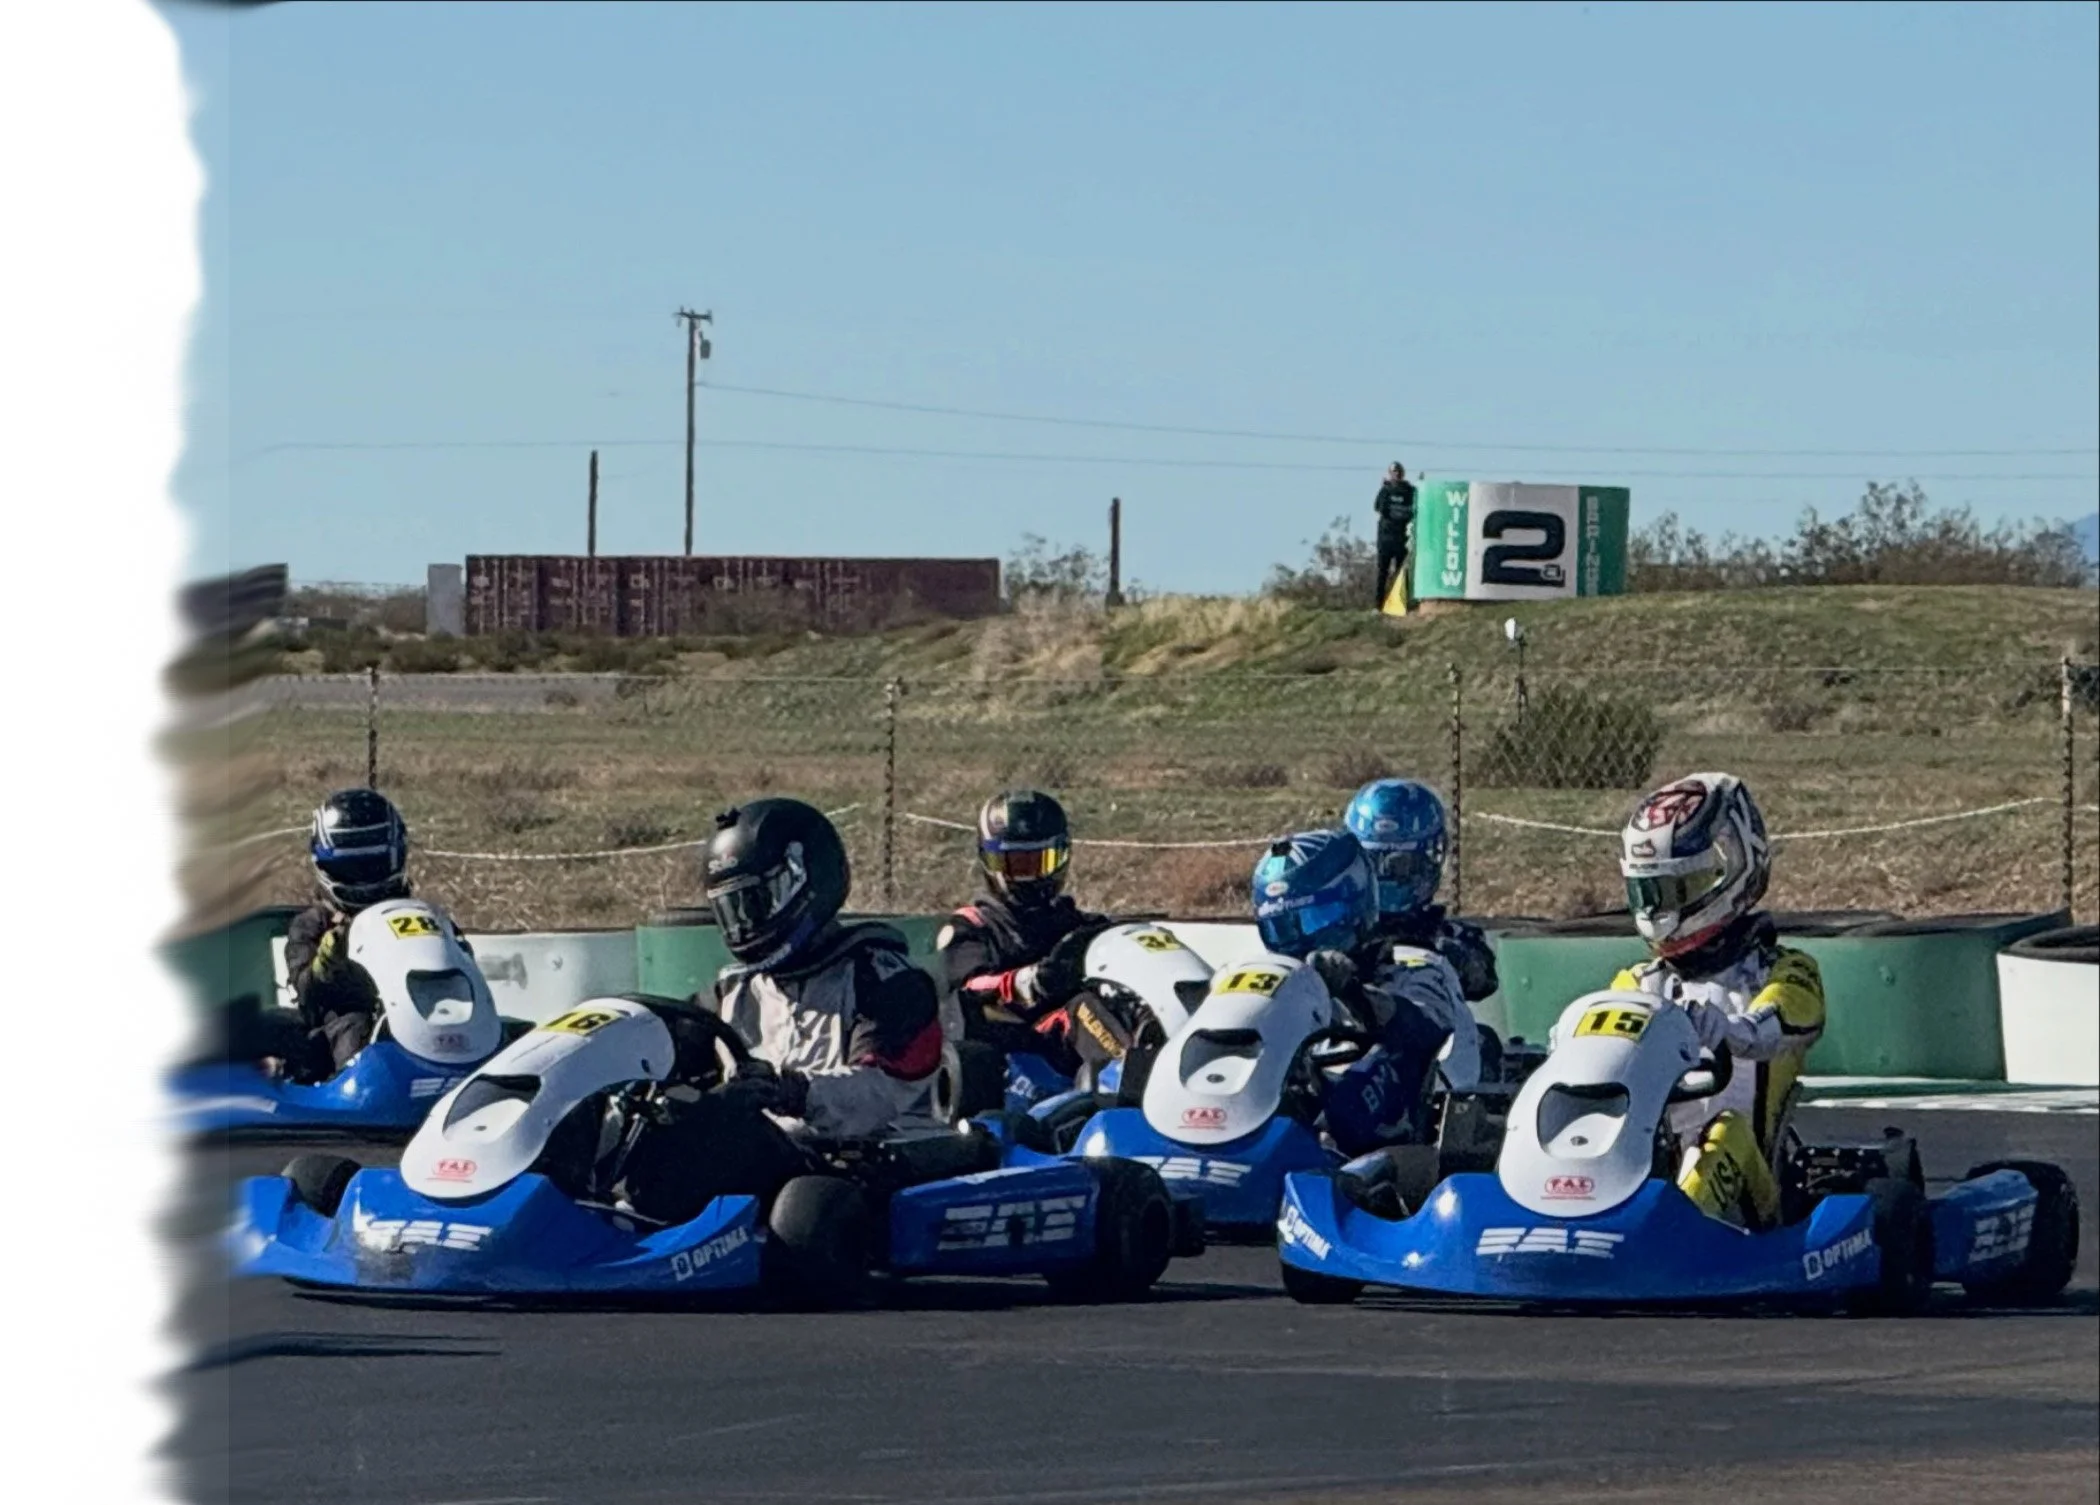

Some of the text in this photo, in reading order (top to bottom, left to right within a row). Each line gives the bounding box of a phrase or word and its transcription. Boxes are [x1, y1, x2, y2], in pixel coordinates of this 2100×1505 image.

[1441, 491, 1468, 587] WILLOW
[1228, 972, 1279, 990] 13
[546, 1012, 611, 1030] 16
[1590, 1011, 1650, 1033] 15
